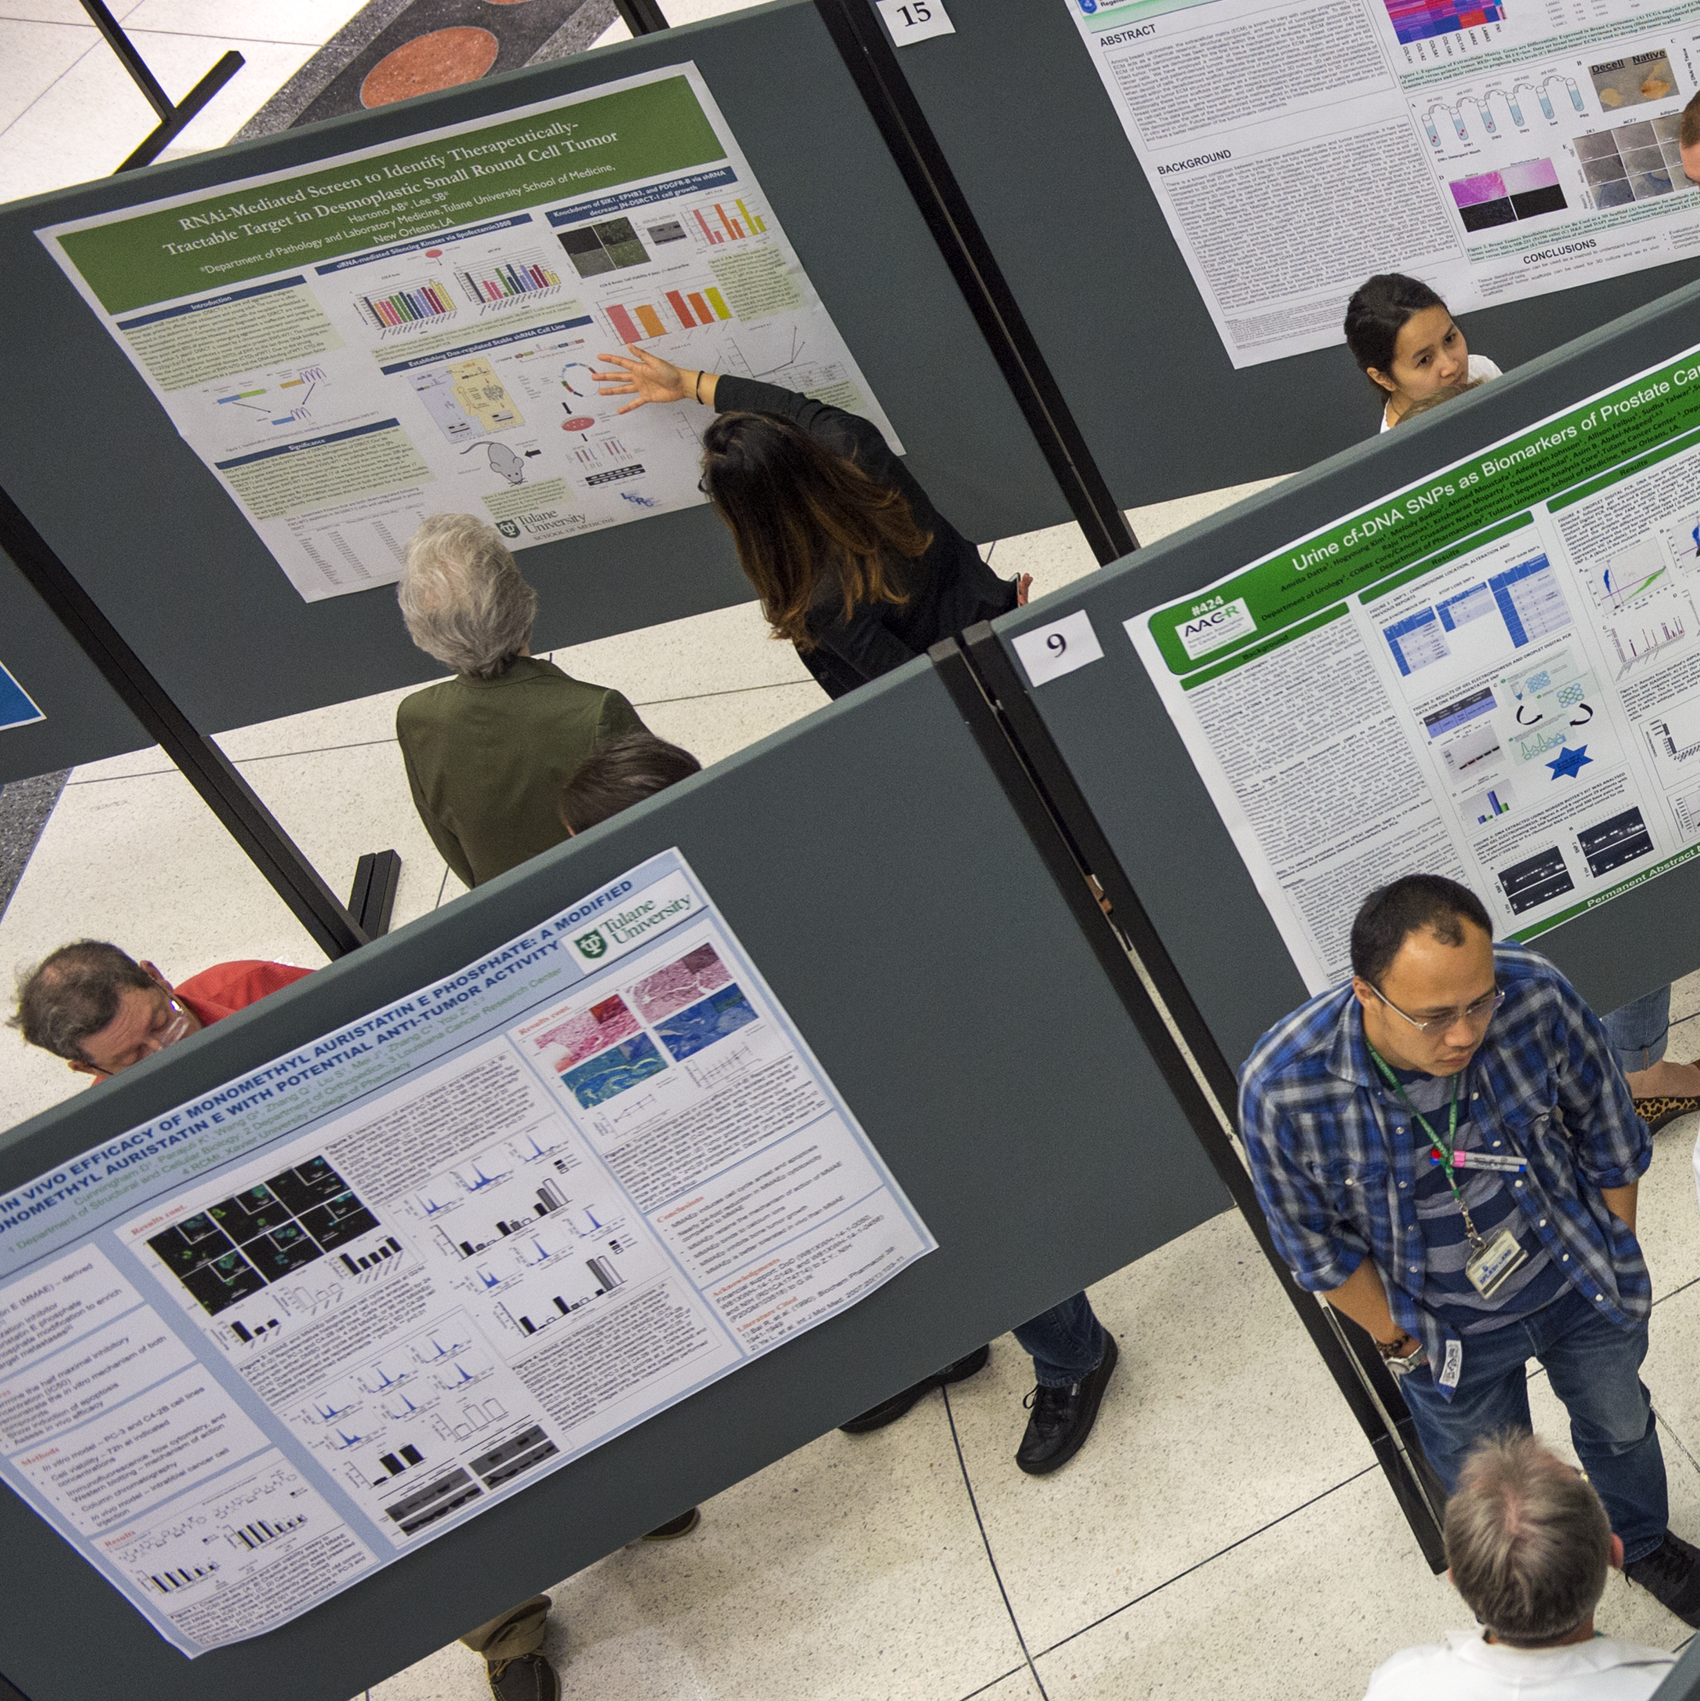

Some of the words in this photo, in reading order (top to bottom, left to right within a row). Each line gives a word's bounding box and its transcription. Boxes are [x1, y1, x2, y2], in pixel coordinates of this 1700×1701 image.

[896, 2, 932, 27] 15
[1100, 23, 1156, 48] ABSTRACT
[1590, 58, 1626, 76] Decell
[1631, 50, 1667, 66] Native
[178, 188, 308, 231] RNAi-Mediated
[306, 178, 363, 199] Screen
[363, 173, 382, 184] to
[381, 154, 446, 179] Identify
[446, 121, 579, 162] Therapeutically-
[1156, 149, 1232, 176] BACKGROUND
[161, 229, 240, 256] Tractable
[237, 216, 294, 236] Target
[293, 210, 314, 223] in
[312, 182, 423, 218] Desmoplastic
[422, 168, 471, 190] Small
[469, 153, 527, 178] Round
[527, 144, 562, 162] Cell
[560, 132, 618, 153] Tumor
[264, 248, 276, 260] of
[274, 238, 323, 256] Pathology
[323, 231, 344, 244] and
[342, 219, 397, 239] Laboratory
[396, 208, 445, 225] Medicine,
[439, 200, 474, 213] Tulane
[472, 187, 522, 206] University
[521, 176, 557, 193] School
[557, 173, 569, 184] of
[568, 164, 617, 181] Medicine,
[346, 208, 391, 225] Hartono
[411, 197, 432, 208] Lee
[372, 232, 398, 244] New
[398, 222, 441, 238] Orleans,
[437, 216, 456, 228] LA
[1522, 238, 1597, 265] CONCLUSIONS
[190, 295, 233, 311] Introduction
[407, 354, 448, 368] Establishing
[445, 341, 493, 358] Dox-regulated
[491, 336, 514, 346] Stable
[513, 330, 538, 341] shRNA
[536, 326, 552, 335] Cell
[550, 324, 566, 332] Line
[287, 438, 326, 452] Significance
[1291, 542, 1340, 571] Urine
[1342, 508, 1405, 547] cf-DNA
[1405, 484, 1456, 515] SNPs
[1458, 471, 1480, 490] as
[1480, 425, 1578, 478] Biomarkers
[1580, 410, 1598, 431] of
[1599, 381, 1671, 422] Prostate
[1619, 459, 1649, 477] Results
[1378, 546, 1423, 573] Department
[1423, 540, 1432, 551] of
[1487, 503, 1514, 518] Tulane
[1512, 485, 1551, 507] University
[1550, 472, 1576, 490] School
[1575, 467, 1584, 478] of
[1584, 453, 1621, 473] Medicine,
[1620, 444, 1638, 456] New
[1637, 430, 1669, 448] Orleans,
[1668, 423, 1682, 433] LA.
[513, 510, 559, 526] Tulane
[523, 513, 587, 534] University
[533, 529, 565, 541] SCHOOL
[576, 517, 615, 531] MEDICINE
[1430, 548, 1461, 566] Results
[1191, 595, 1224, 617] #424
[1185, 605, 1240, 638] AACR
[1046, 633, 1067, 658] 9
[1241, 634, 1290, 661] Background
[1586, 875, 1648, 908] Permanent
[1650, 848, 1696, 876] Abstract
[598, 899, 656, 934] Tulane
[610, 894, 691, 945] University
[518, 1019, 550, 1035] Results
[0, 1197, 21, 1214] IN
[21, 1173, 67, 1200] VIVO
[68, 1127, 154, 1176] EFFICACY
[158, 1114, 182, 1132] OF
[185, 1054, 312, 1119] MONOMETHYL
[313, 1002, 416, 1058] AURISTATIN
[416, 994, 432, 1008] E
[431, 938, 538, 1000] PHOSPHATE:
[540, 928, 554, 941] A
[553, 880, 633, 932] MODIFIED
[105, 1119, 210, 1176] AURISTATIN
[210, 1111, 226, 1124] E
[225, 1087, 274, 1116] WITH
[275, 1042, 374, 1093] POTENTIAL
[376, 985, 483, 1045] ANTI-TUMOR
[484, 939, 559, 989] ACTIVITY
[656, 1196, 704, 1223] Conclusions
[130, 1216, 163, 1236] Results
[21, 1446, 60, 1467] Methods
[104, 1529, 136, 1548] Results
